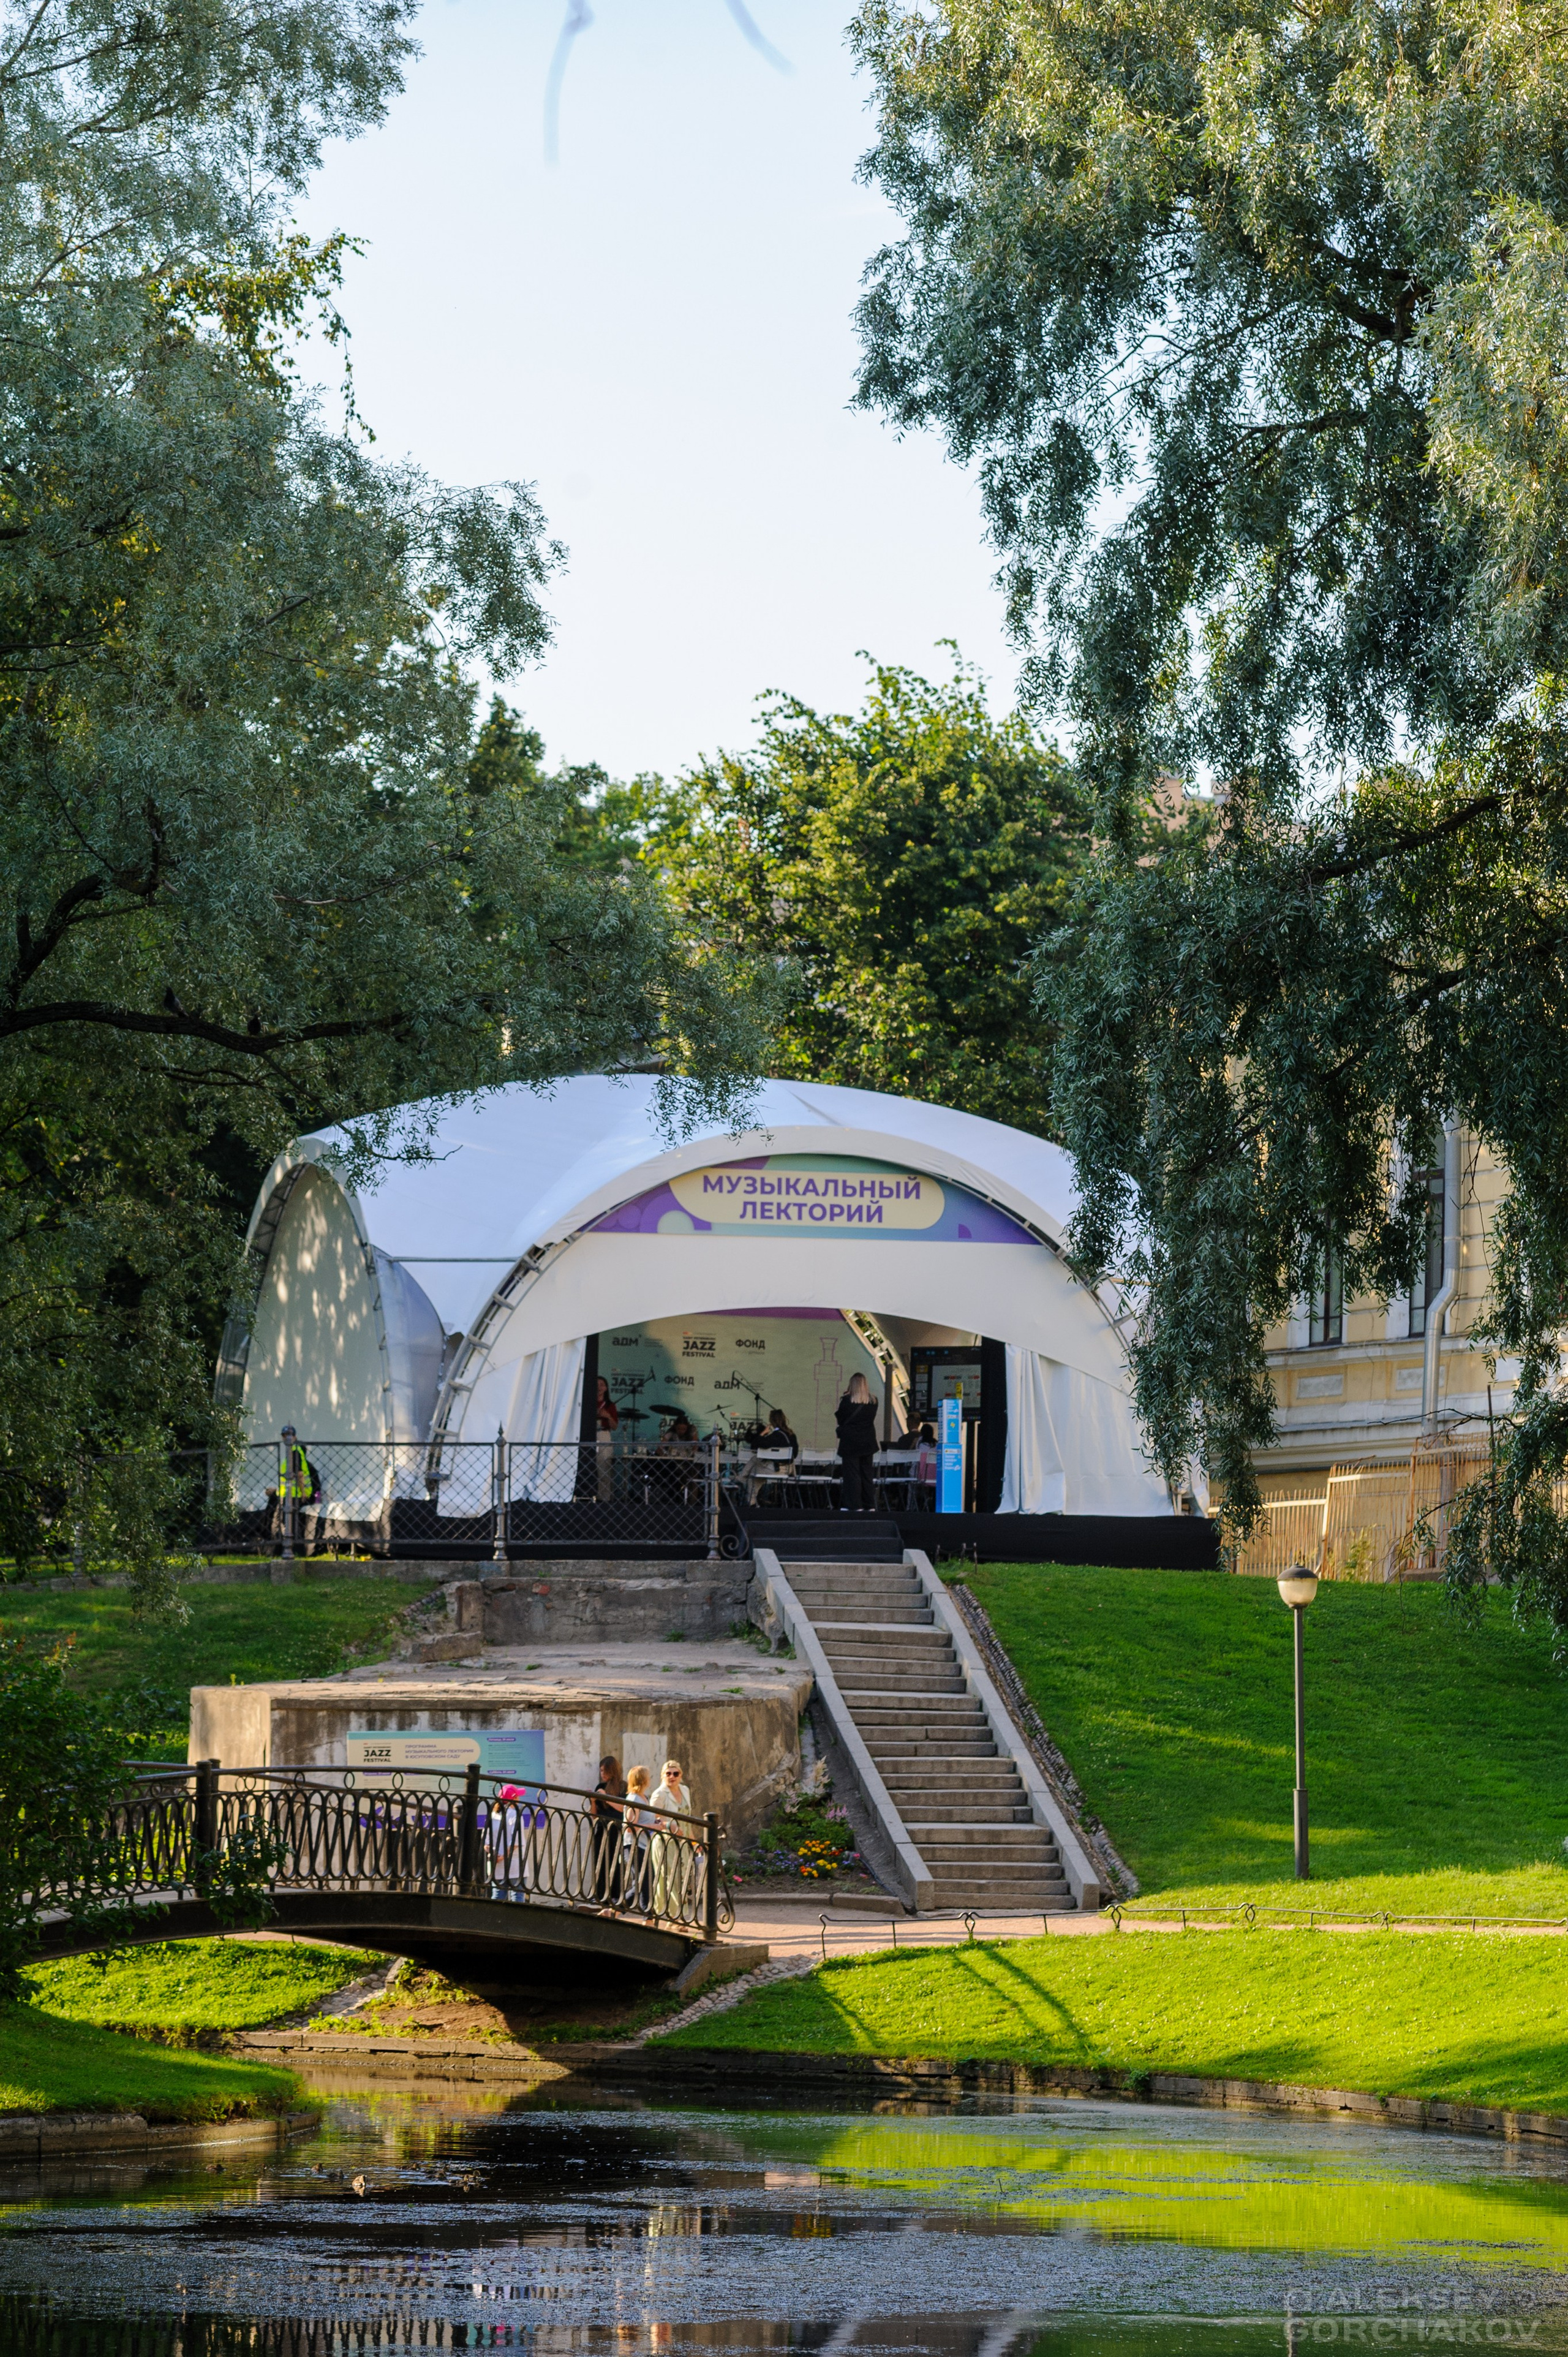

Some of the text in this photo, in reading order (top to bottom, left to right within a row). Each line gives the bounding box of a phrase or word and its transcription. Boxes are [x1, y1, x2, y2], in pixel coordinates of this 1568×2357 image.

[702, 1175, 921, 1200] МУЗЫКАЛЬНЫЙ
[739, 1200, 883, 1224] ЛЕКТОРИЙ
[683, 1341, 715, 1350] JAZZ
[736, 1339, 766, 1350] ФОНД
[612, 1377, 644, 1387] JAZZ
[665, 1375, 695, 1387] ФОНД
